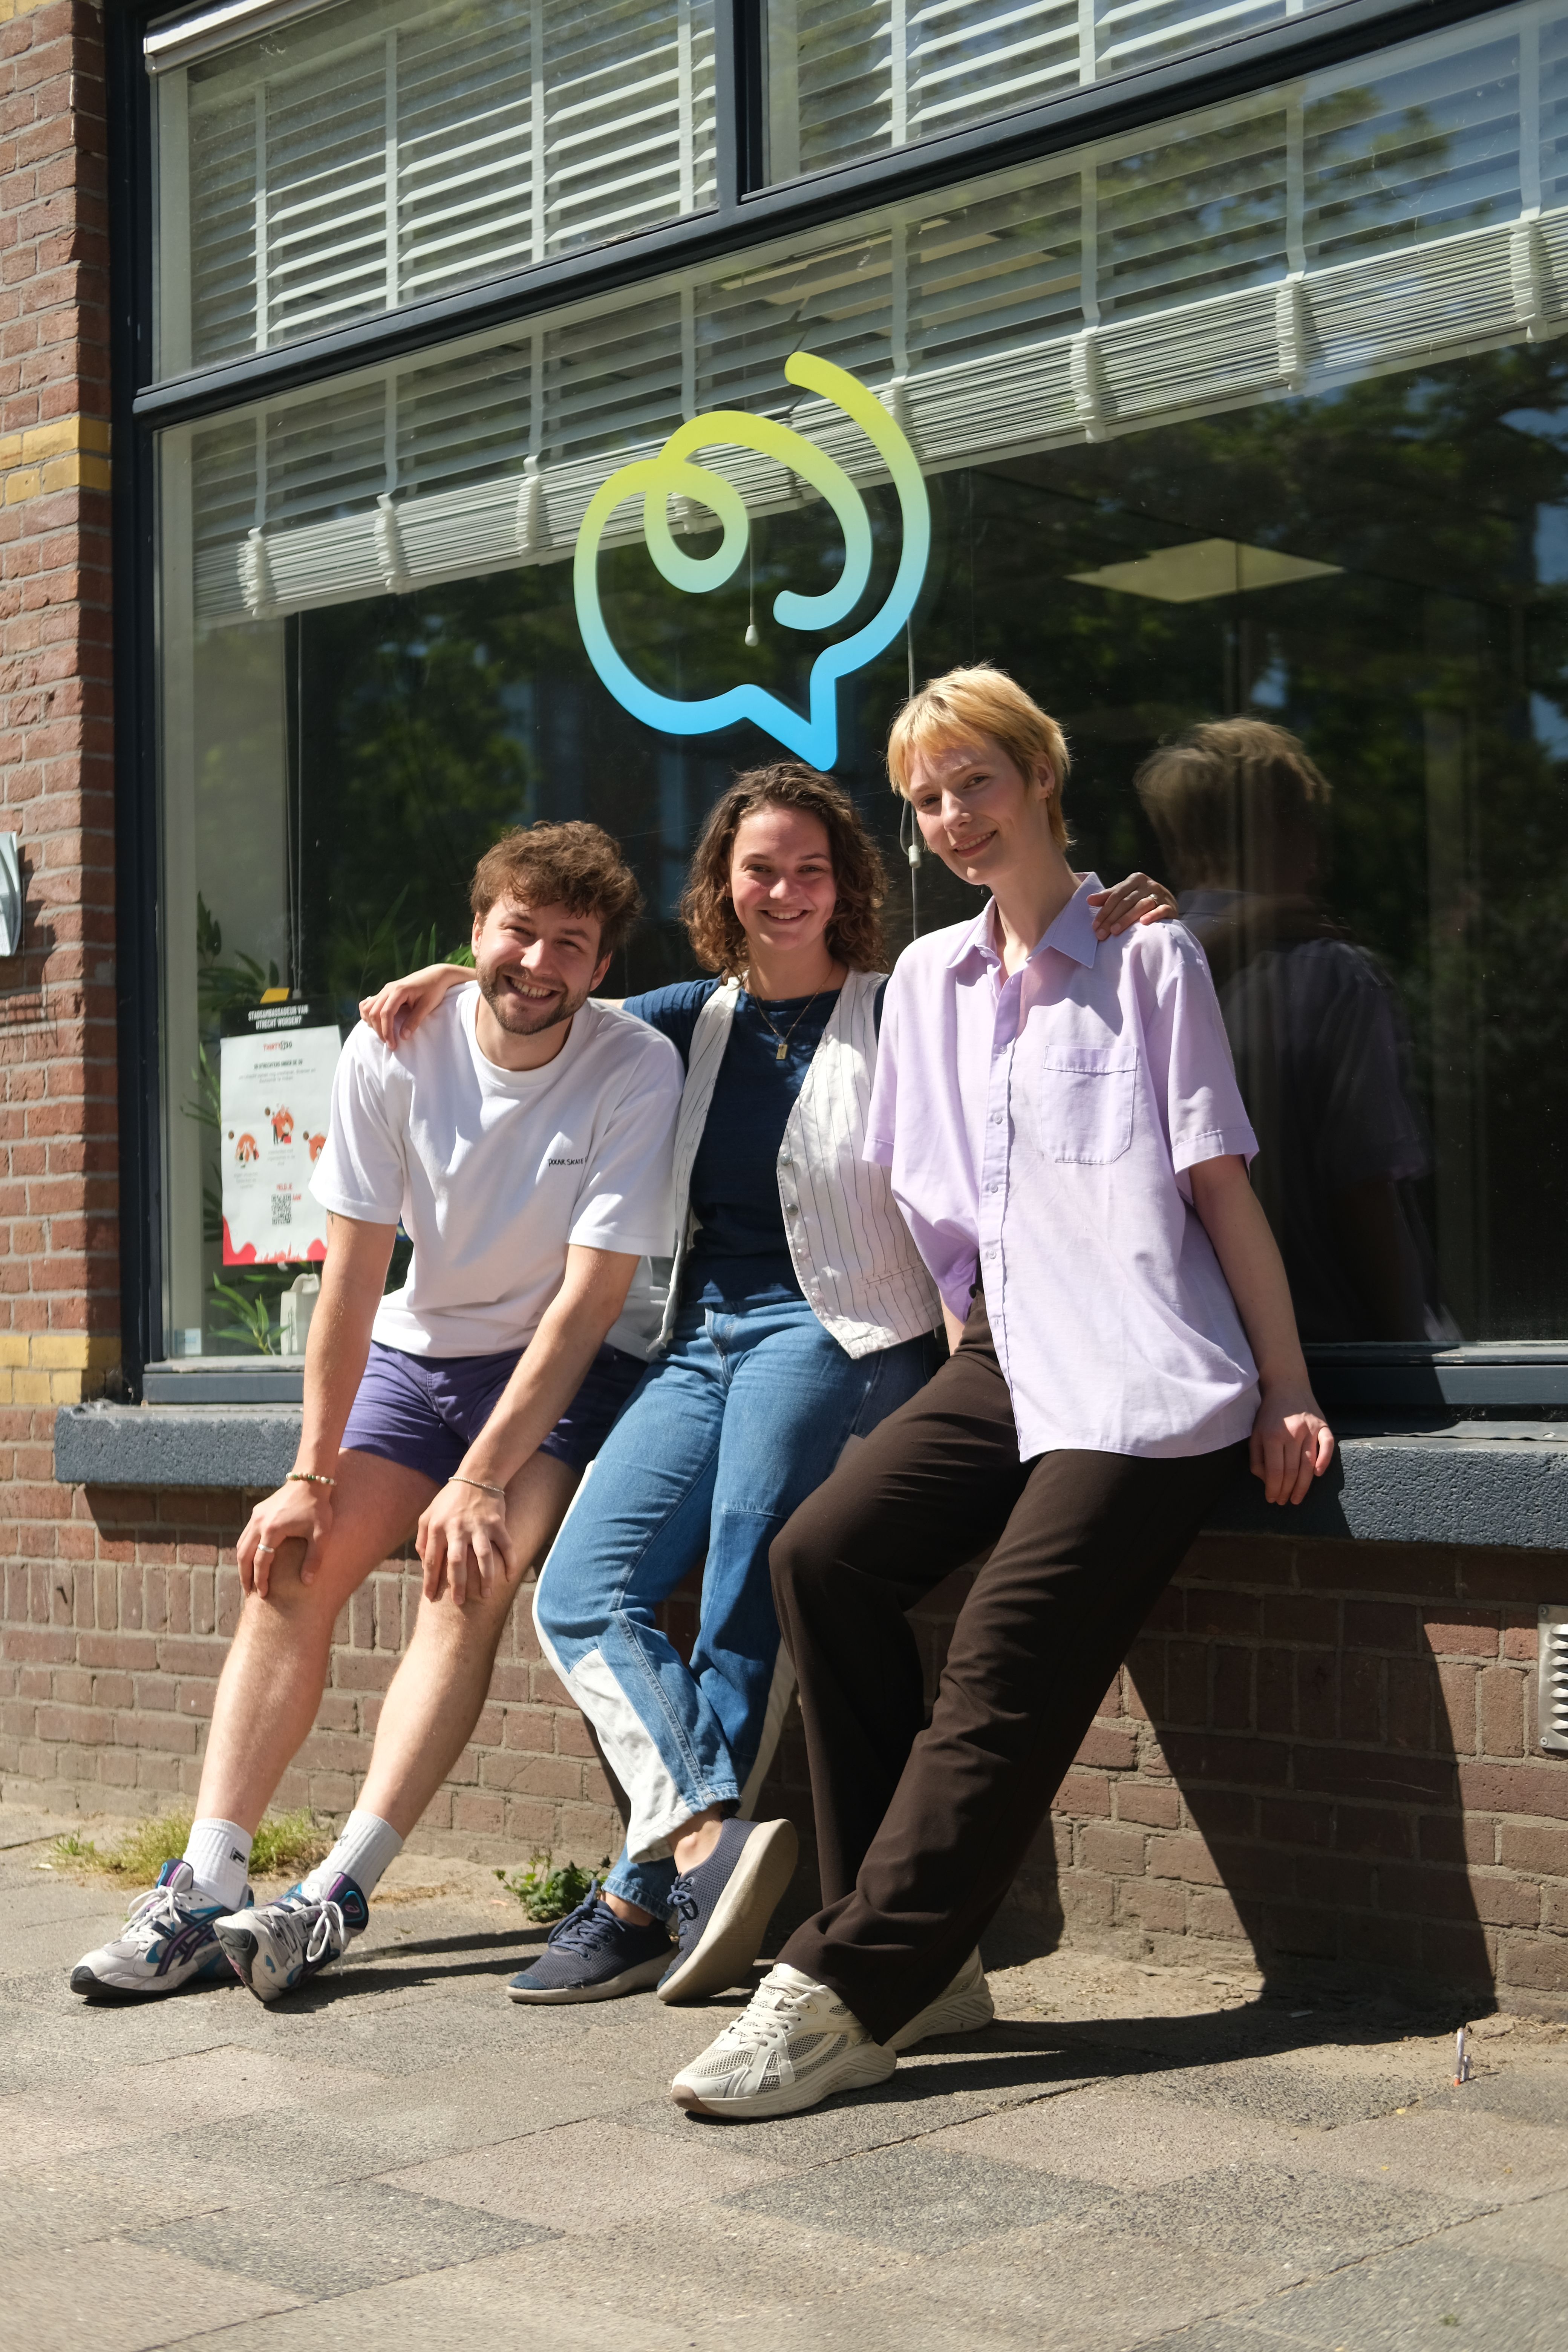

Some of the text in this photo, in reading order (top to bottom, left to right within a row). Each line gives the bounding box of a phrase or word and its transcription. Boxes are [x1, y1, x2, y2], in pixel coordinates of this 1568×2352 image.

[248, 1004, 309, 1021] STADSAMBASSADEUR VAN
[256, 1015, 302, 1031] UTRECHT WORDEN?
[548, 1158, 566, 1167] POLAR
